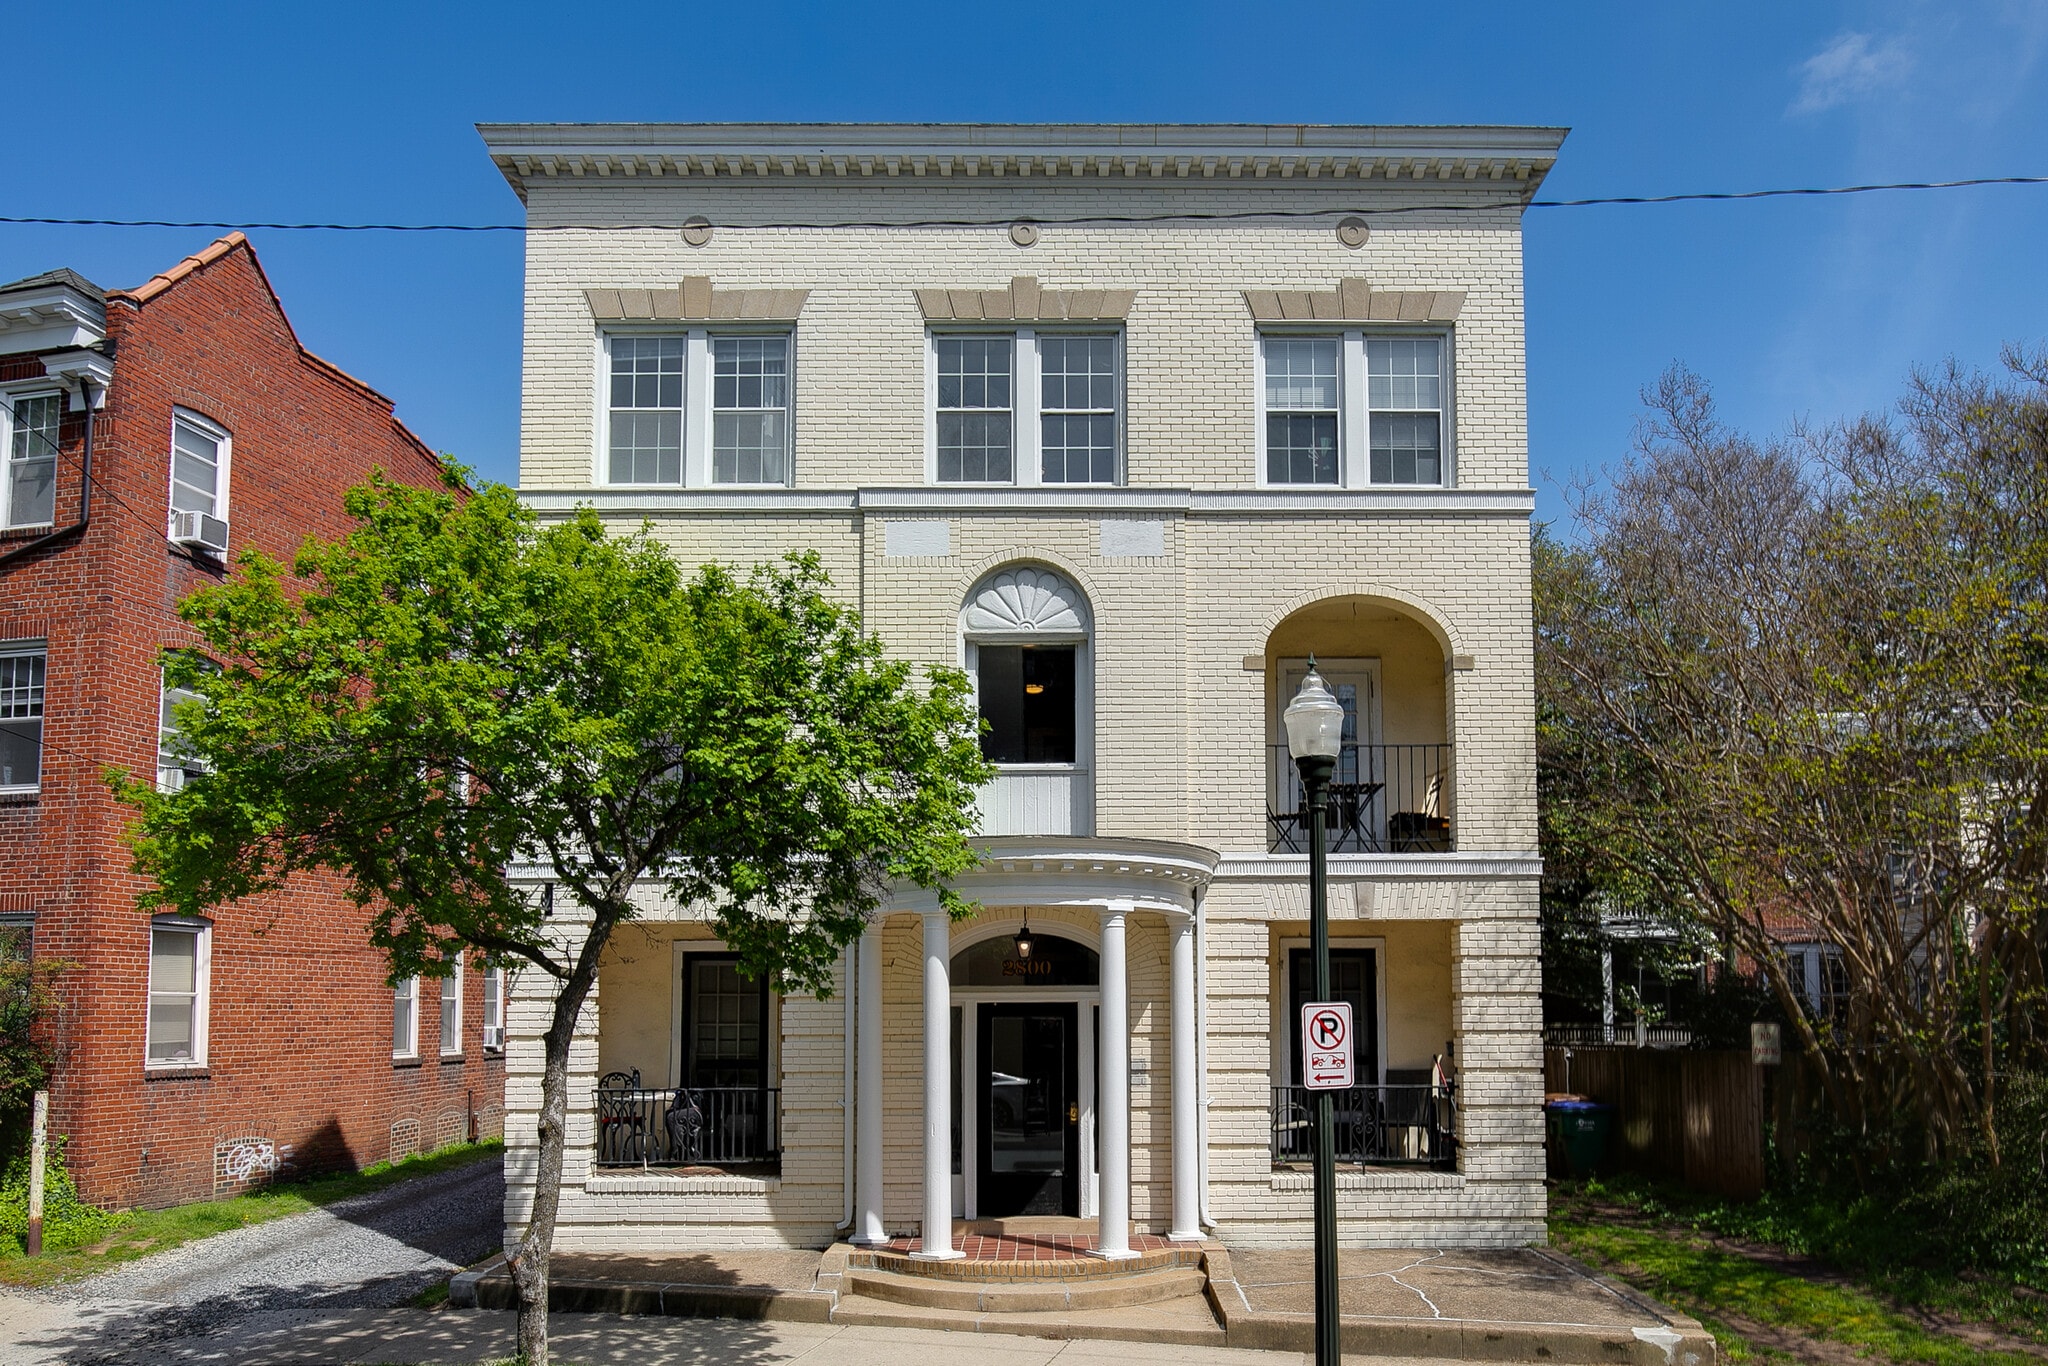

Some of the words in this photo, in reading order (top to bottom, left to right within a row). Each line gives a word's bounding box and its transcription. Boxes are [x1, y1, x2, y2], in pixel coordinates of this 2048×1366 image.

[1001, 959, 1052, 977] 2800
[1320, 1017, 1339, 1044] P
[1760, 1031, 1771, 1041] NO
